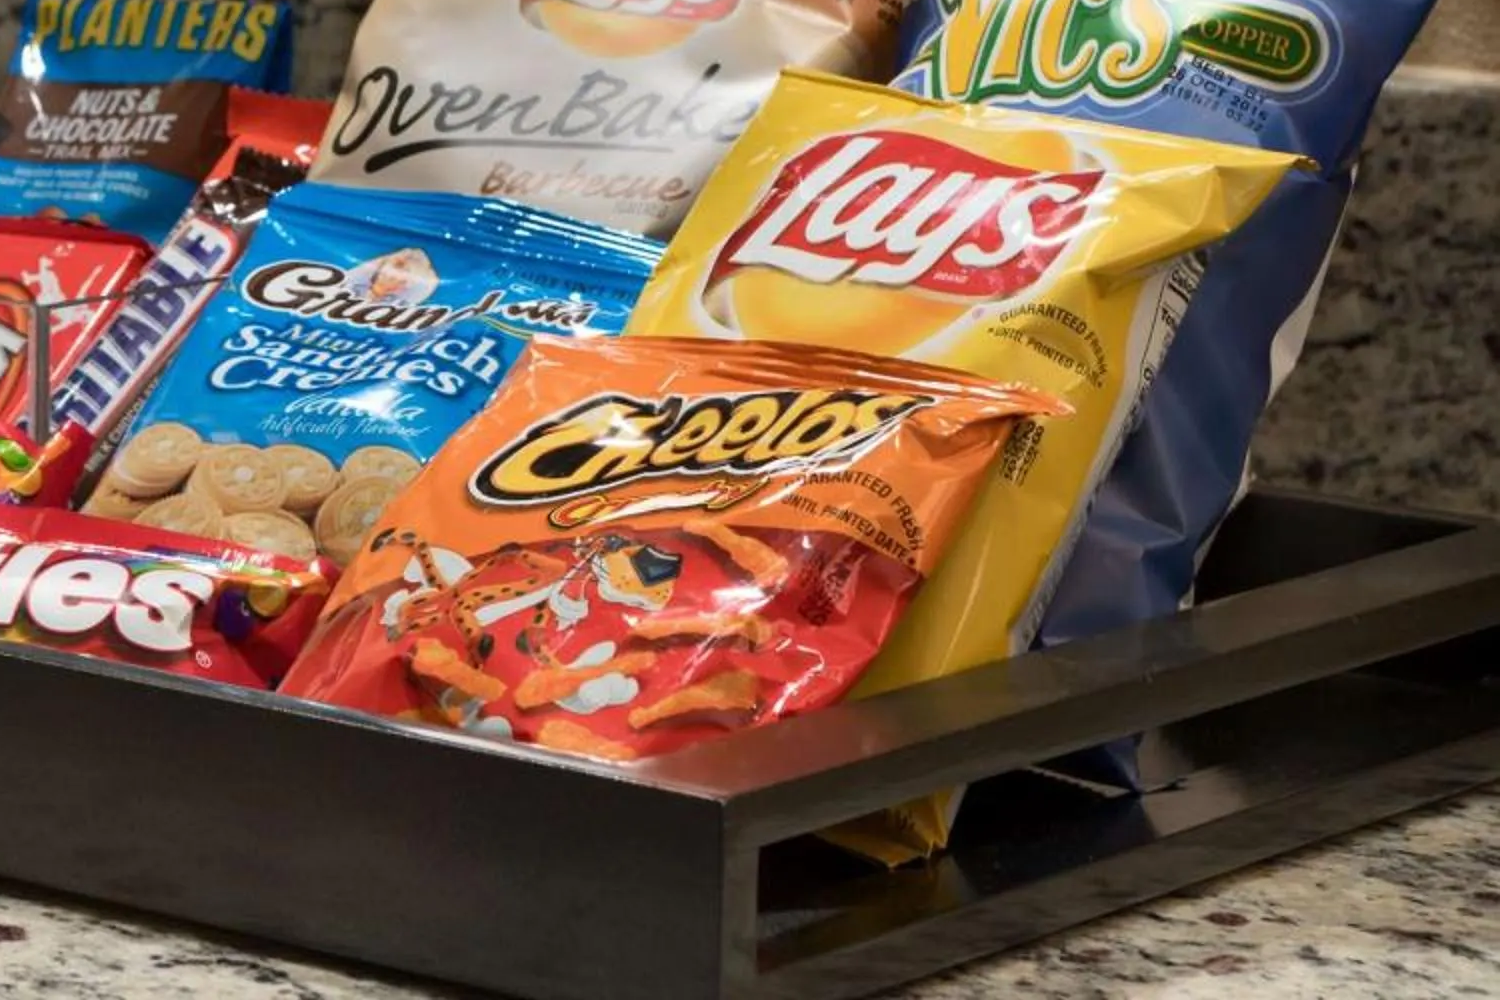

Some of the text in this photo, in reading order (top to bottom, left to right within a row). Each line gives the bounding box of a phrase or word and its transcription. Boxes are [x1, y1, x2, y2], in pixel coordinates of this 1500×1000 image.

[1198, 18, 1291, 62] OPPER
[70, 88, 141, 115] NUTS
[332, 63, 762, 156] Oven Bake
[25, 113, 179, 144] CHOCOLATE
[479, 160, 692, 202] Barbecue
[731, 136, 1105, 284] Lay's
[999, 303, 1088, 335] GUARANTEED
[222, 325, 500, 384] Sandich
[1026, 336, 1075, 370] PRINTED
[480, 388, 920, 498] Cheetos
[785, 470, 893, 499] ARANTEED
[819, 504, 876, 538] PRINTED
[874, 530, 908, 560] DATE
